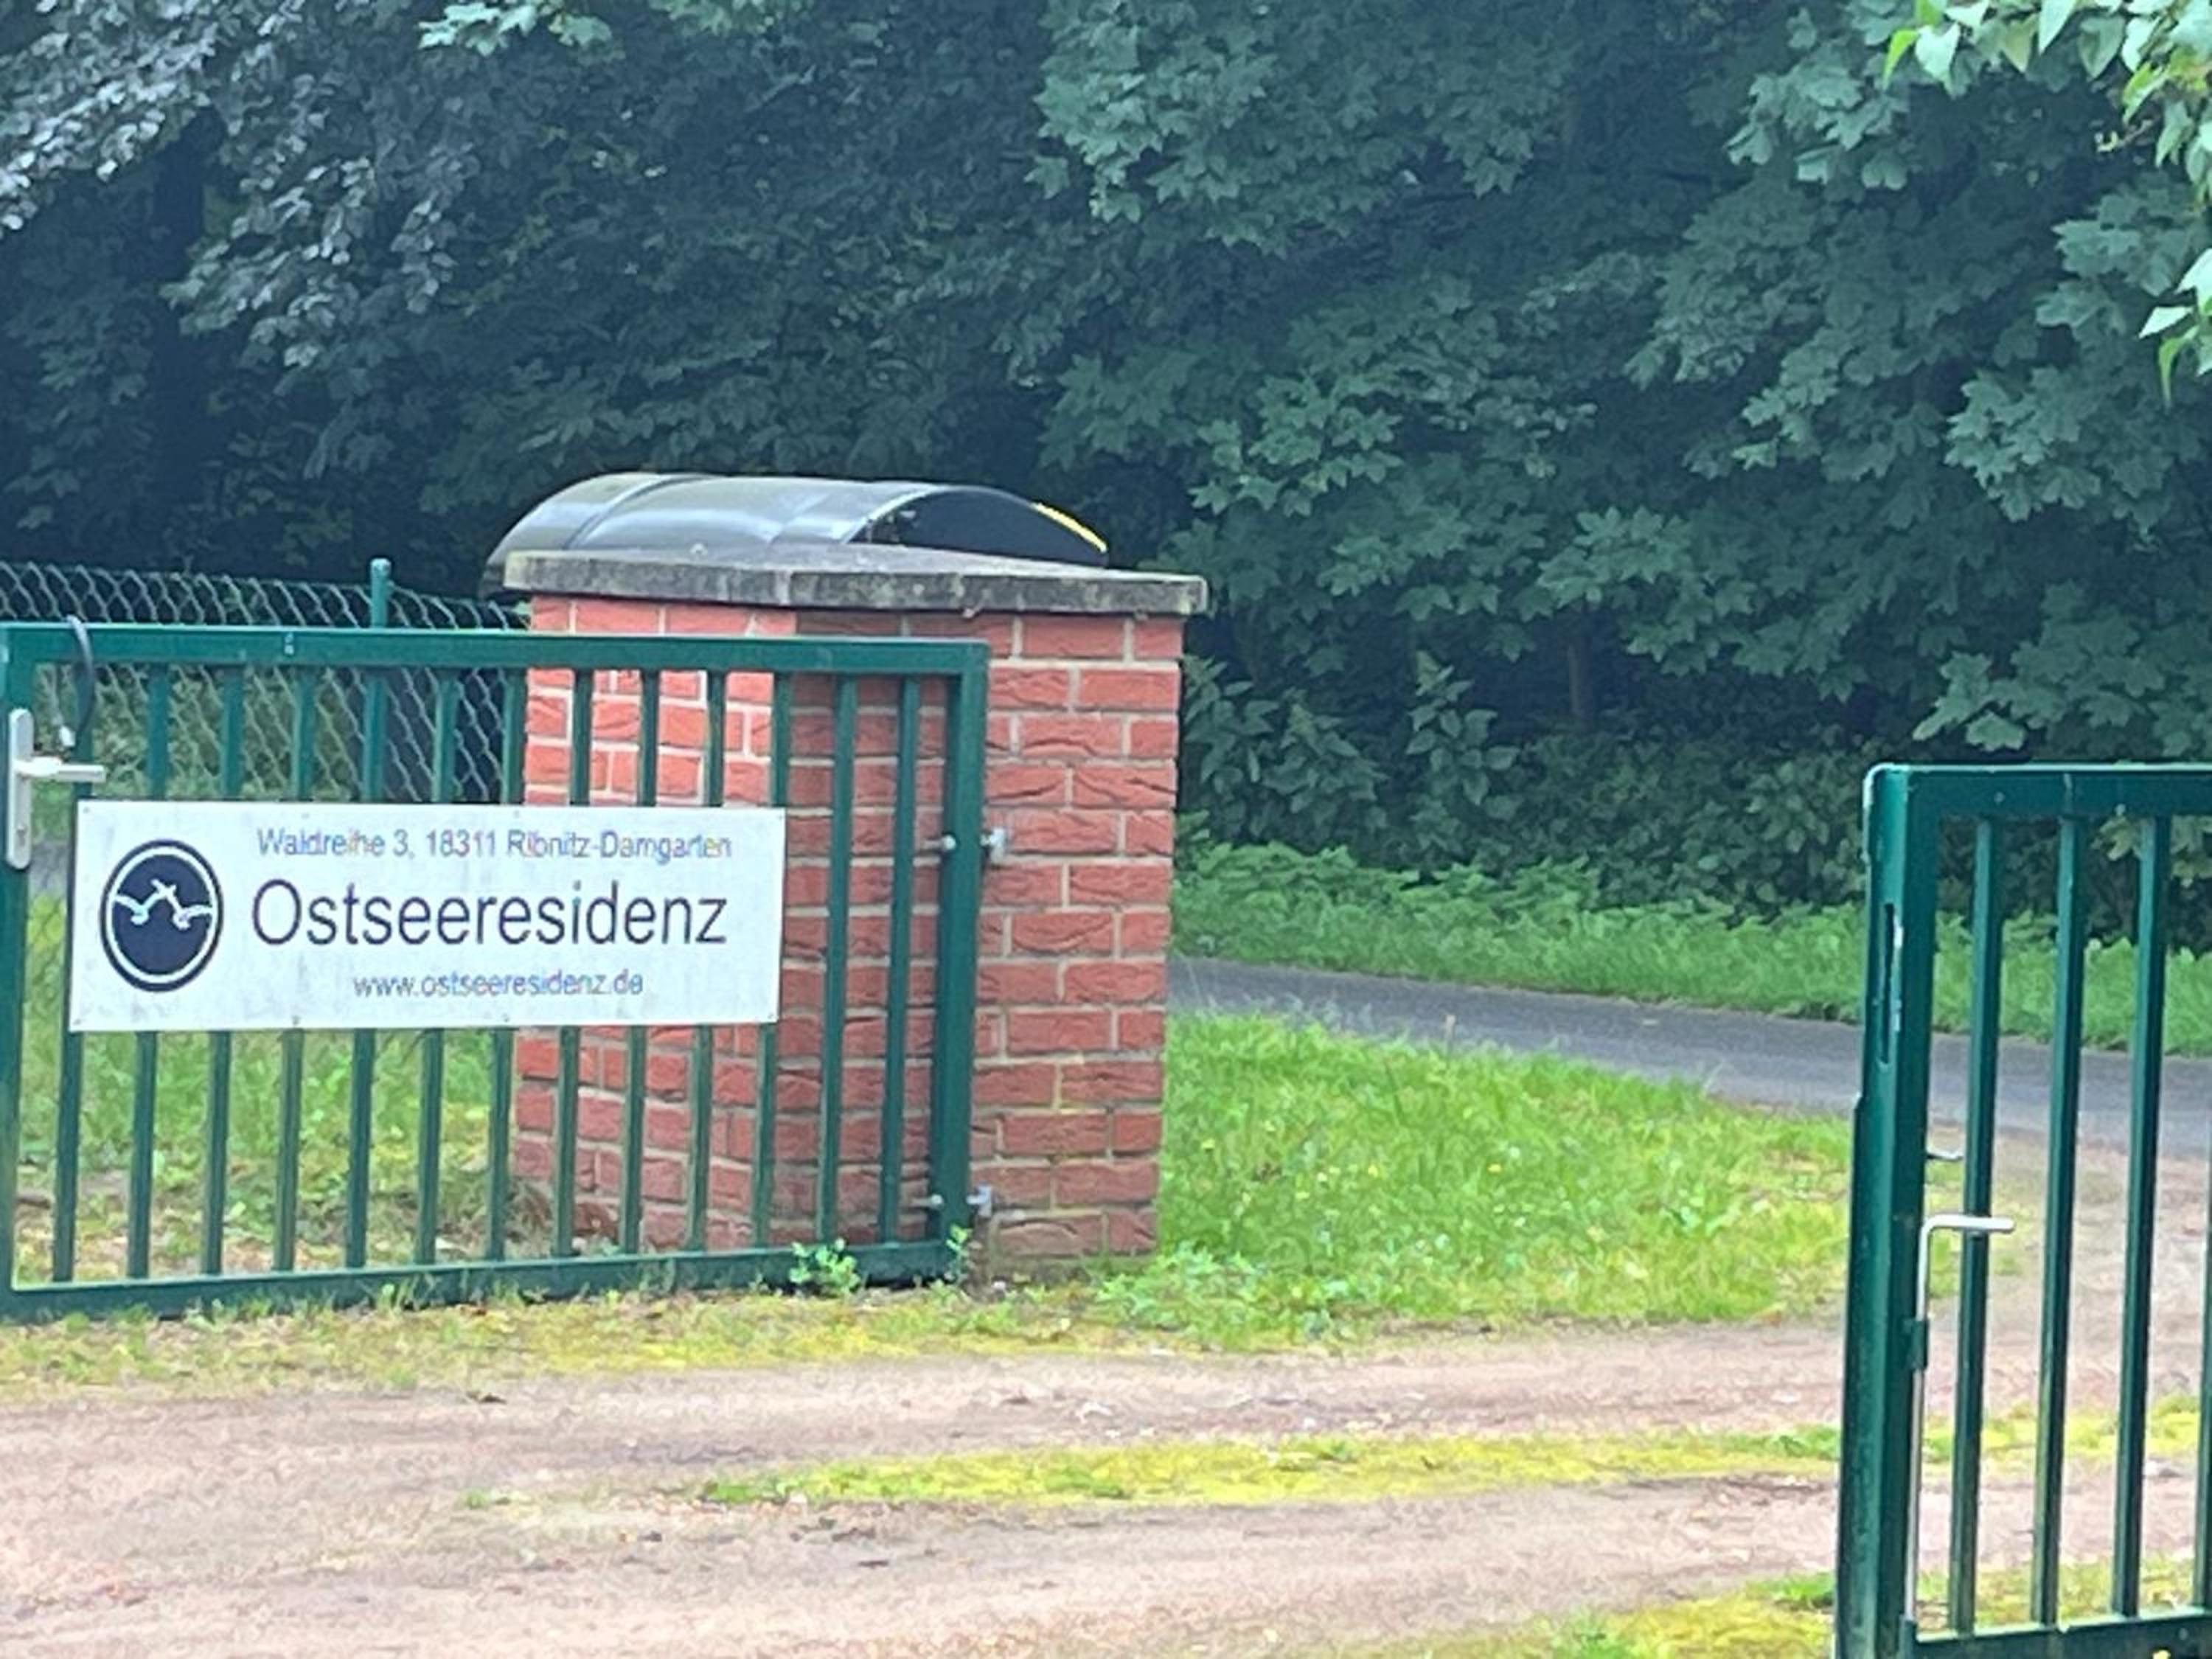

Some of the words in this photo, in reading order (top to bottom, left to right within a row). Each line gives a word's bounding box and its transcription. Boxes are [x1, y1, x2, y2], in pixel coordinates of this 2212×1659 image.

[257, 827, 386, 856] Waldreihe
[393, 829, 415, 859] 3,
[426, 830, 496, 858] 18311
[507, 830, 732, 865] Ribnitz-Damgarten
[253, 878, 728, 945] Ostseeresidenz
[354, 970, 644, 997] www.ostseeresidenz.de
